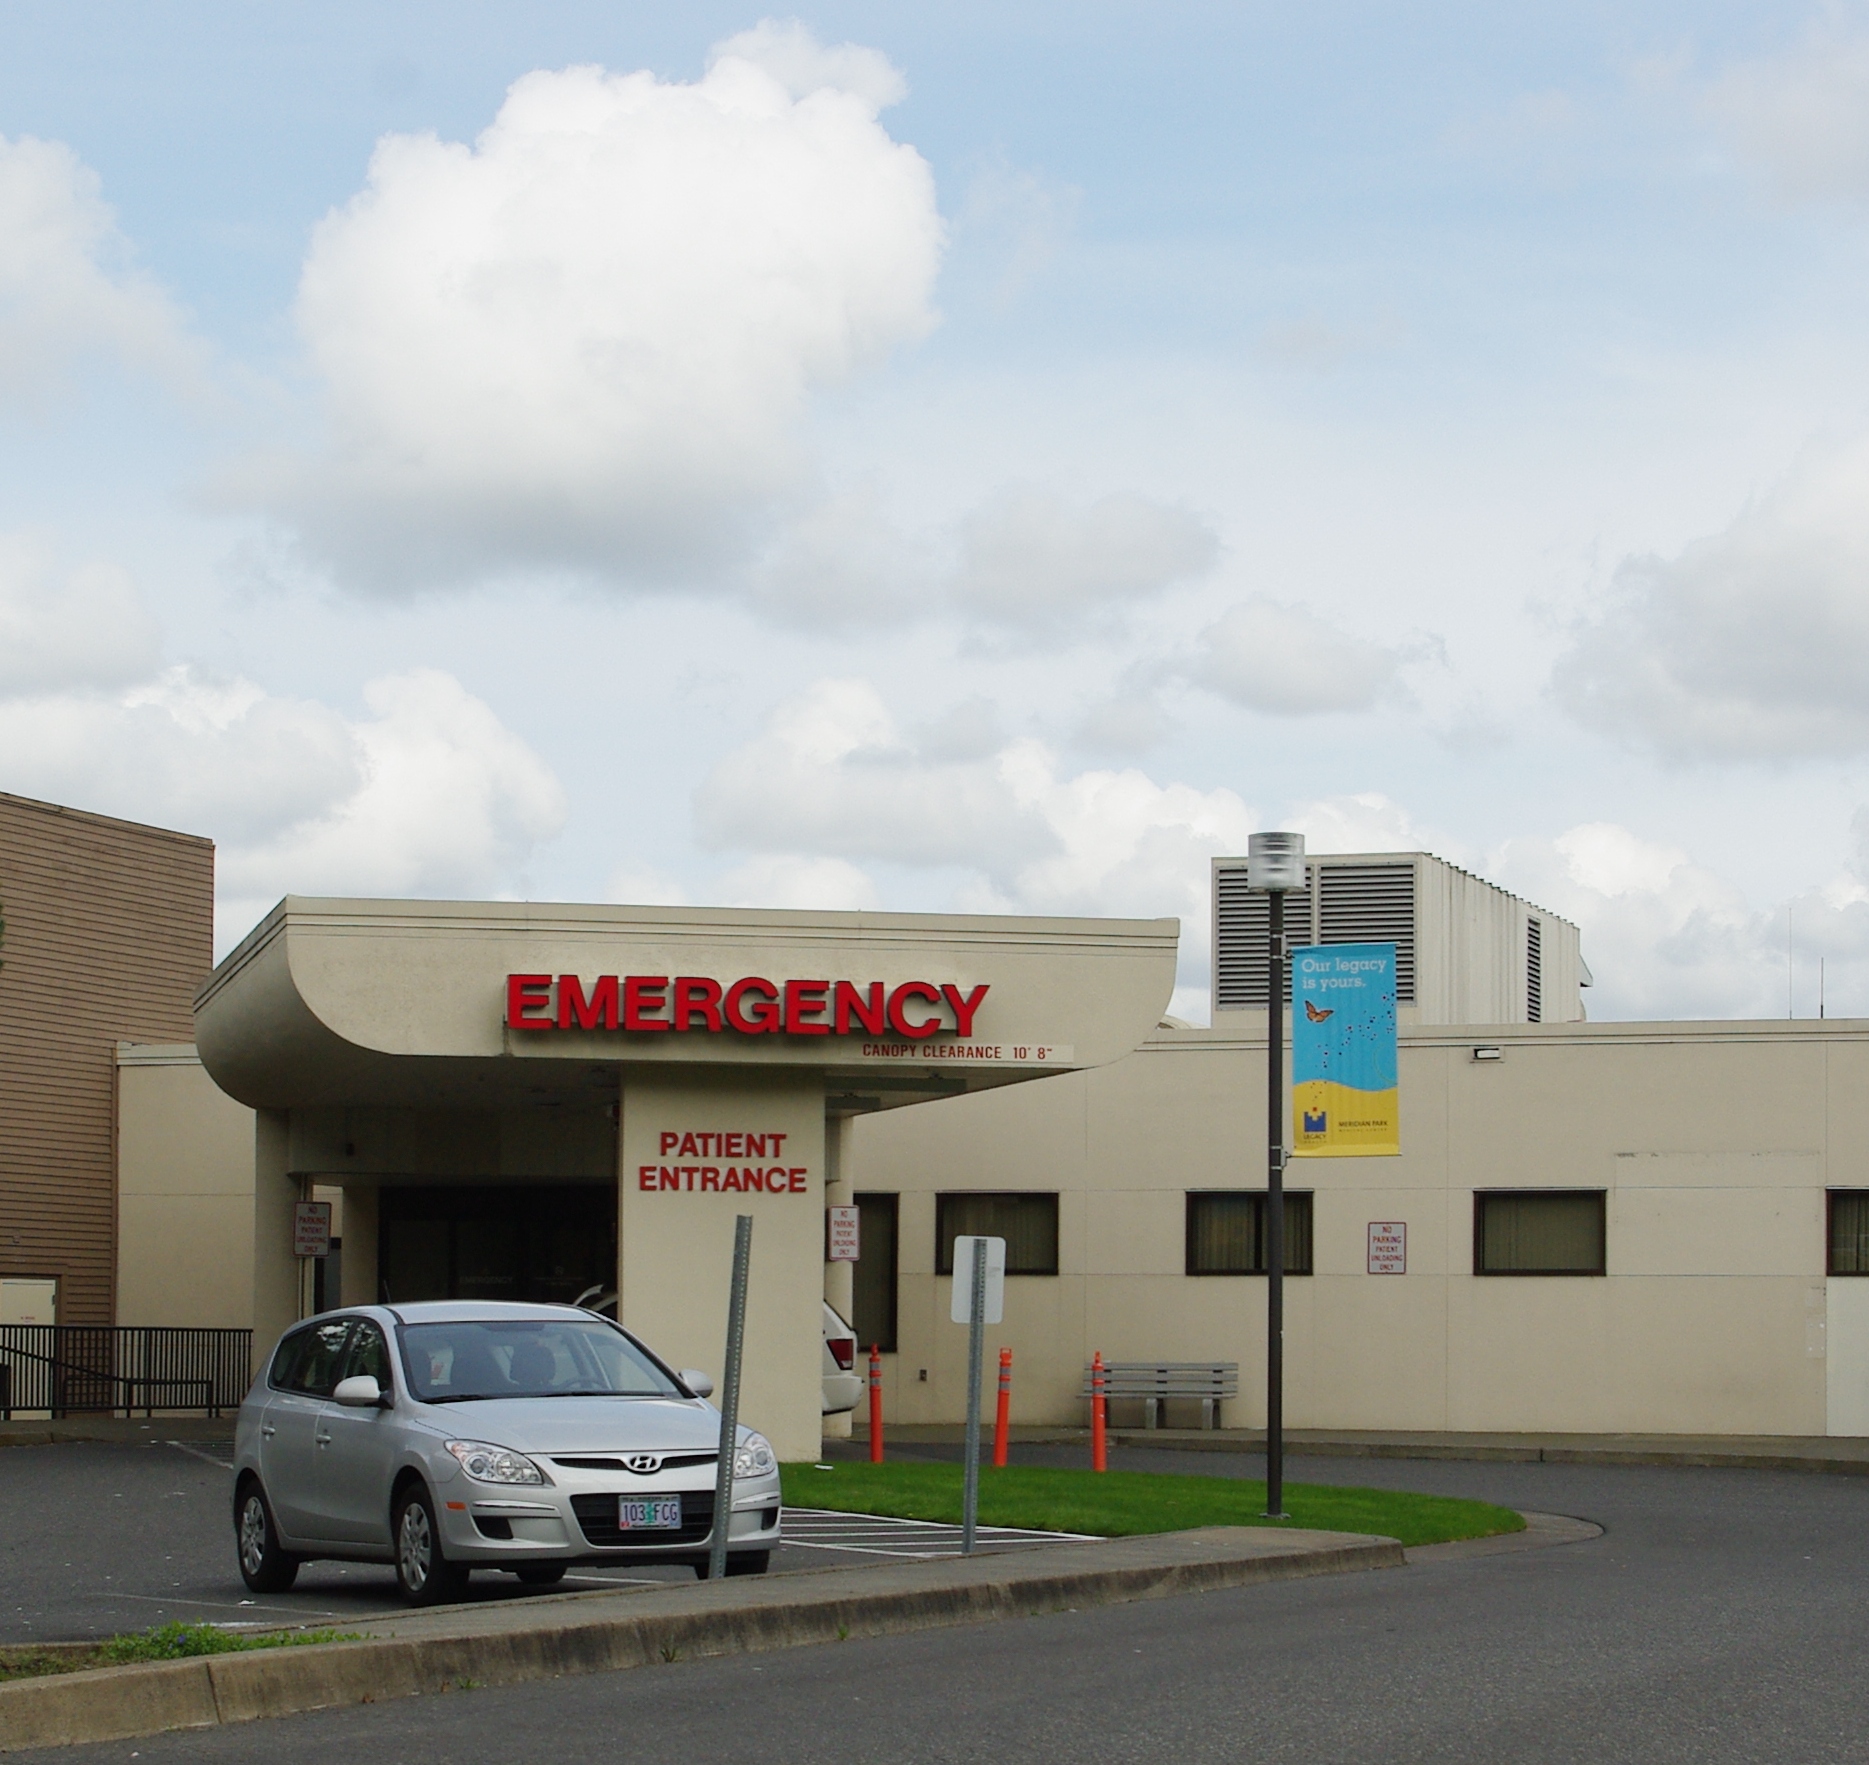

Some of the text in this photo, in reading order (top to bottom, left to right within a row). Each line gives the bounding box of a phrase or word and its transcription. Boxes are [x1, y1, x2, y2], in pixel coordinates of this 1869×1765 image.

[1301, 957, 1387, 974] Our legacy
[1302, 976, 1367, 992] is yours.
[507, 974, 991, 1038] EMERGENCY
[862, 1043, 917, 1058] CANOPY
[922, 1044, 1002, 1059] CLEARANCE
[1338, 1120, 1371, 1128] MERIDIAN
[659, 1131, 788, 1158] PATIENT
[638, 1165, 808, 1194] ENTRANCE
[299, 1216, 326, 1225] PARKING
[840, 1210, 848, 1218] NO
[833, 1220, 855, 1228] PARKING
[1382, 1225, 1392, 1233] NO
[623, 1503, 677, 1521] 103 FCG
